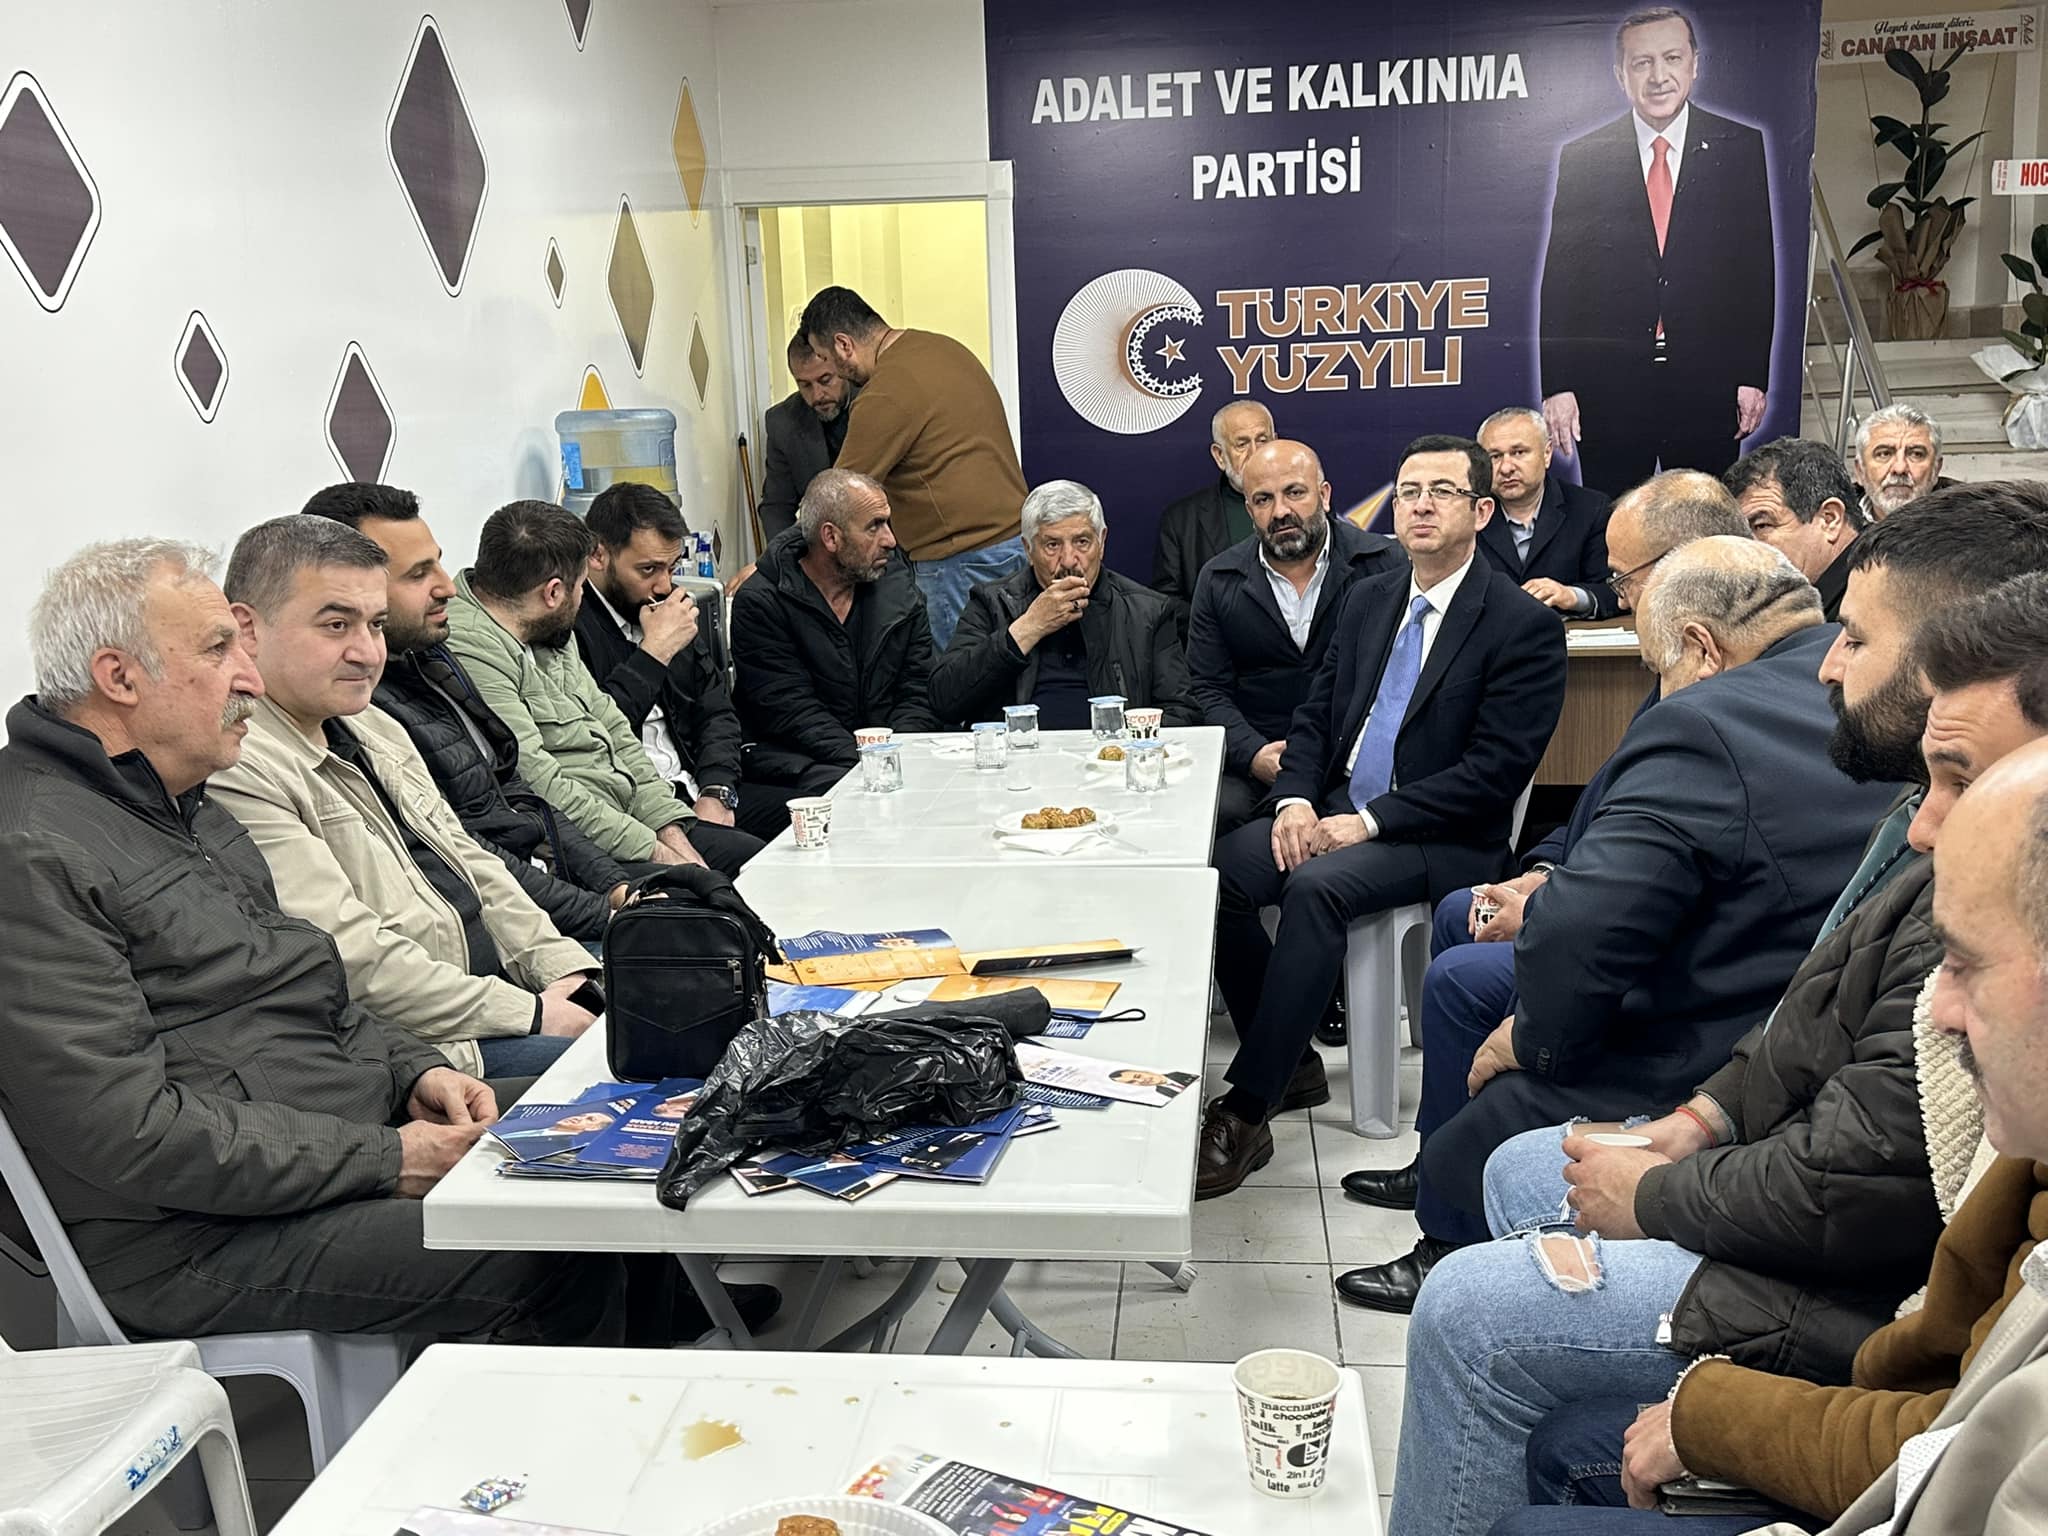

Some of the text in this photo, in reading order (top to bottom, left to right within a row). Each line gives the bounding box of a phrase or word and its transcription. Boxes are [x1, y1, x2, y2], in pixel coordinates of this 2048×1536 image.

[1841, 27, 2018, 57] CANATAN İNŞAAT
[1031, 53, 1529, 124] ADALET VE KALKINMA
[1192, 136, 1361, 200] PARTİSİ
[1216, 277, 1490, 340] TÜRKİYE
[1216, 336, 1463, 395] YÜZYILI
[1261, 1401, 1323, 1412] macchiato
[1250, 1419, 1276, 1432] milk
[1267, 1479, 1290, 1492] latte
[1286, 1469, 1307, 1479] 2in1
